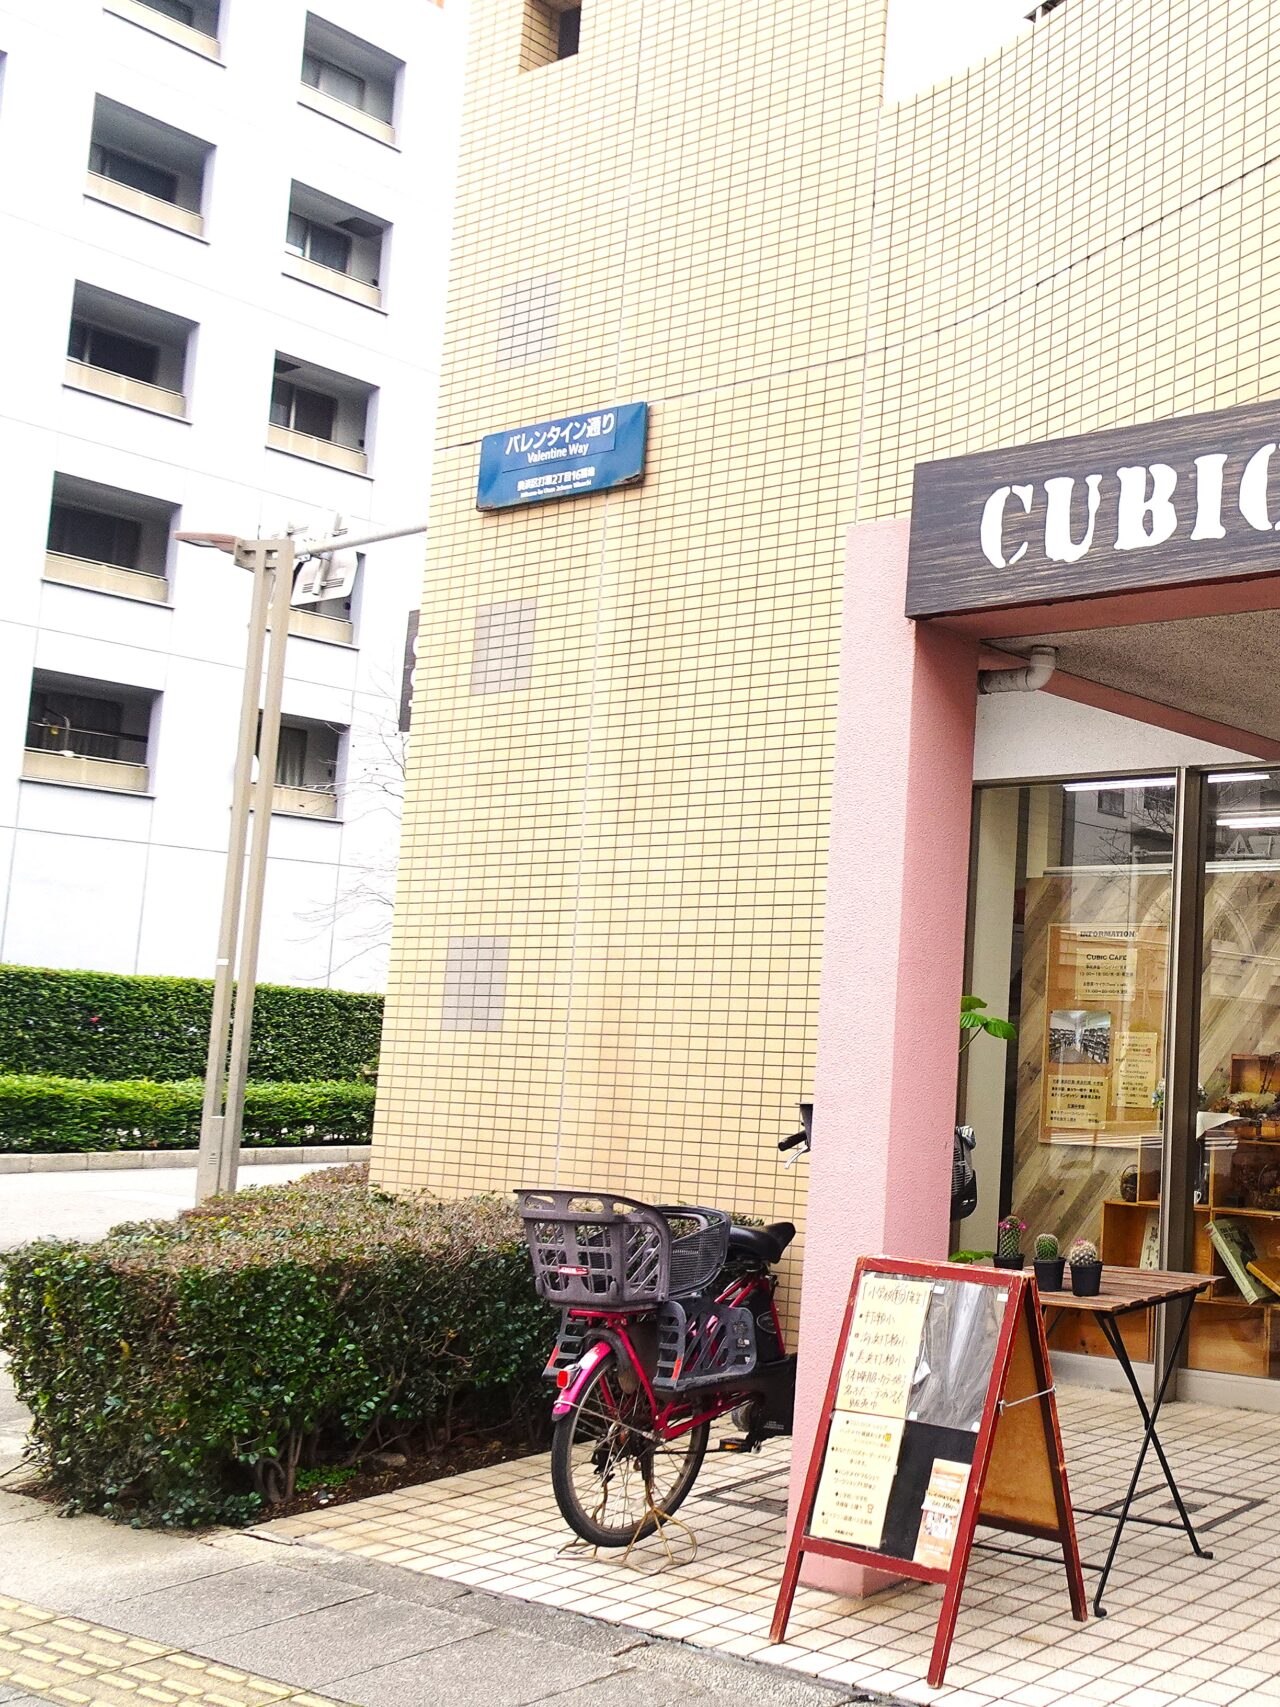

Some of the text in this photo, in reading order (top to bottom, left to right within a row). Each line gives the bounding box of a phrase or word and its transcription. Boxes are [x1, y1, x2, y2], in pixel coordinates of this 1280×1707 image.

[505, 412, 615, 456] バレンタイン通り
[527, 442, 589, 464] Valentine Way
[1080, 930, 1136, 938] INFORMATION
